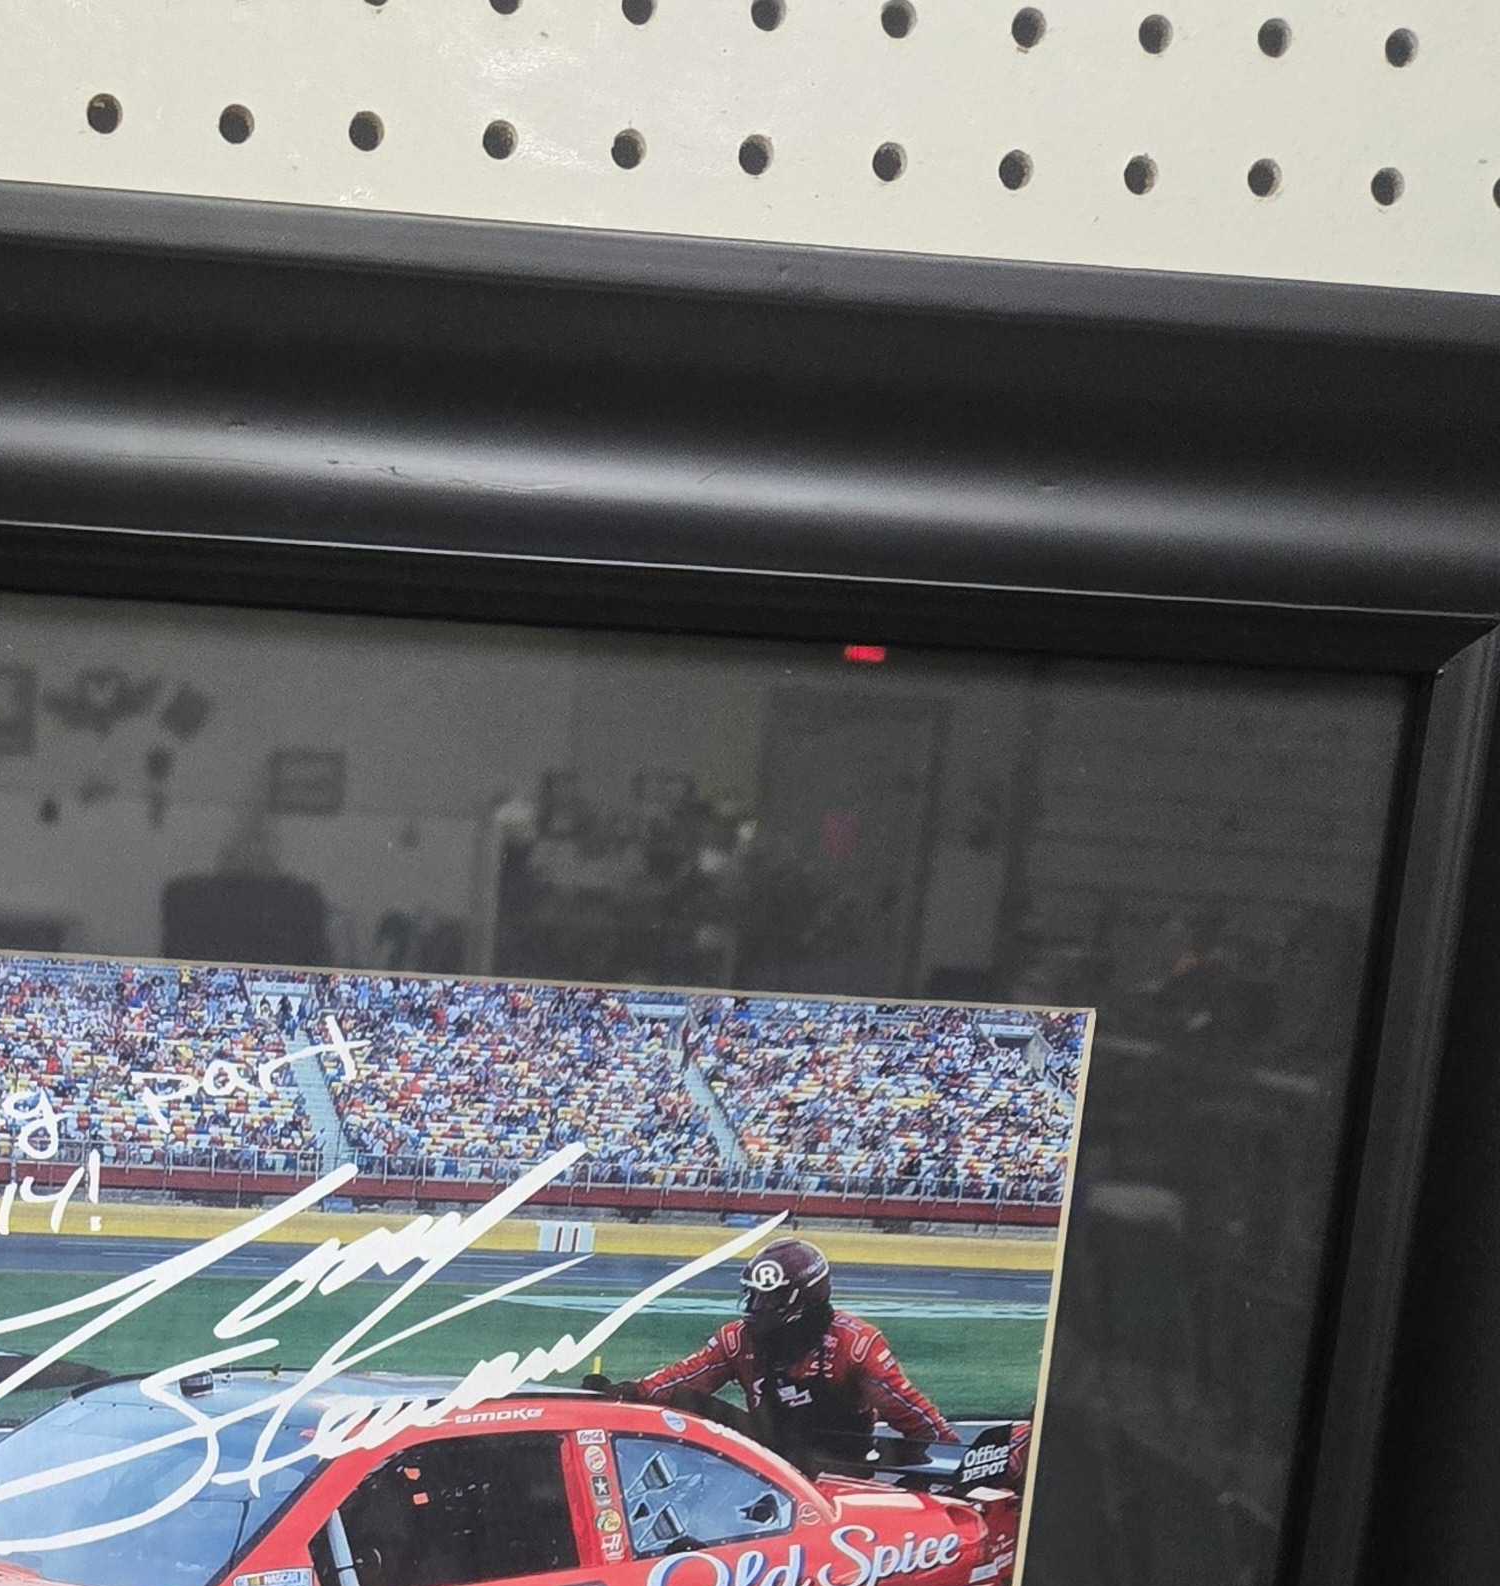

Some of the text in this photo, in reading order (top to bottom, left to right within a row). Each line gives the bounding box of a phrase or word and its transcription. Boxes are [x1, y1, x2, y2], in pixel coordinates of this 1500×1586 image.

[130, 1015, 370, 1133] part
[963, 1443, 1009, 1468] Office
[961, 1459, 1008, 1484] DEPOT
